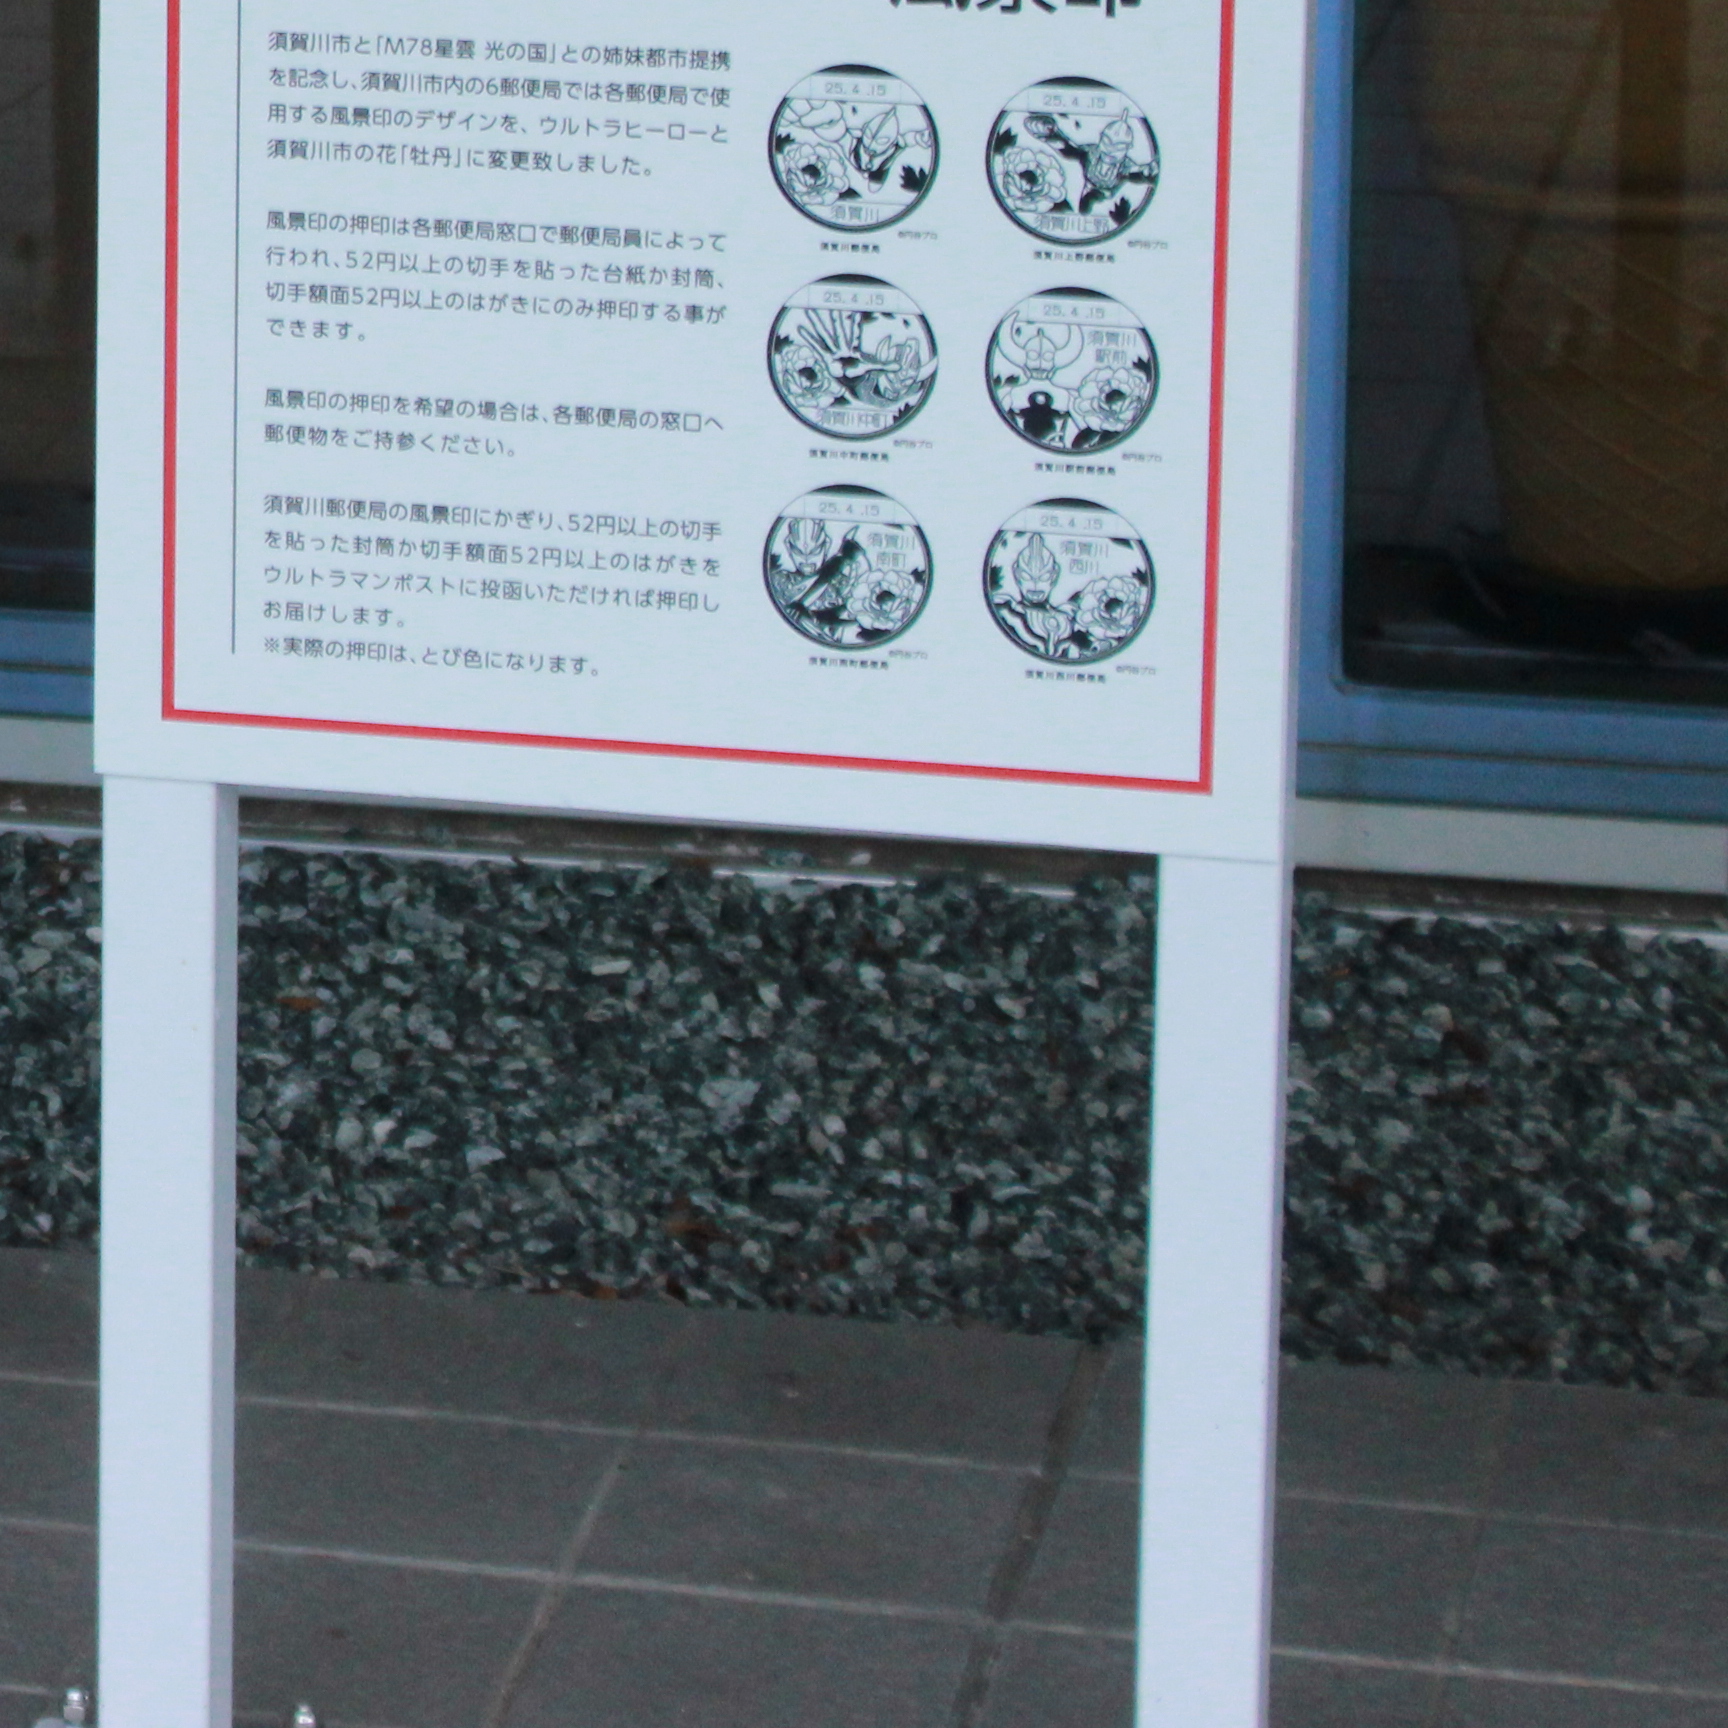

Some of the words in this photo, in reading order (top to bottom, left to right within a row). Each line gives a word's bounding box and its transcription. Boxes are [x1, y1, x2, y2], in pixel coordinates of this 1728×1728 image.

[269, 68, 731, 108] を記念し、須賀川市内の6郵便局では各郵便局で使
[267, 139, 652, 177] 須賀川市の花「牡丹」に変更致しました。
[266, 211, 727, 252] 風景印の押印は各郵便局窓口で郵便局員によって
[265, 281, 727, 325] 切手額面52円以上のはがきにのみ押印する事が
[266, 317, 366, 342] できます。
[264, 388, 723, 433] 風景印の押印を希望の場合は、各郵便局の窓口へ
[263, 423, 515, 458] 郵便物をご持参ください。
[263, 494, 722, 542] 須賀川郵便局の風景印にかぎり、52円以上の切手
[263, 566, 720, 613] ウルトラマンポストに投函いただければ押印し
[263, 601, 405, 628] お届けします。
[263, 637, 599, 677] ※実際の押印は、とび色になります。
